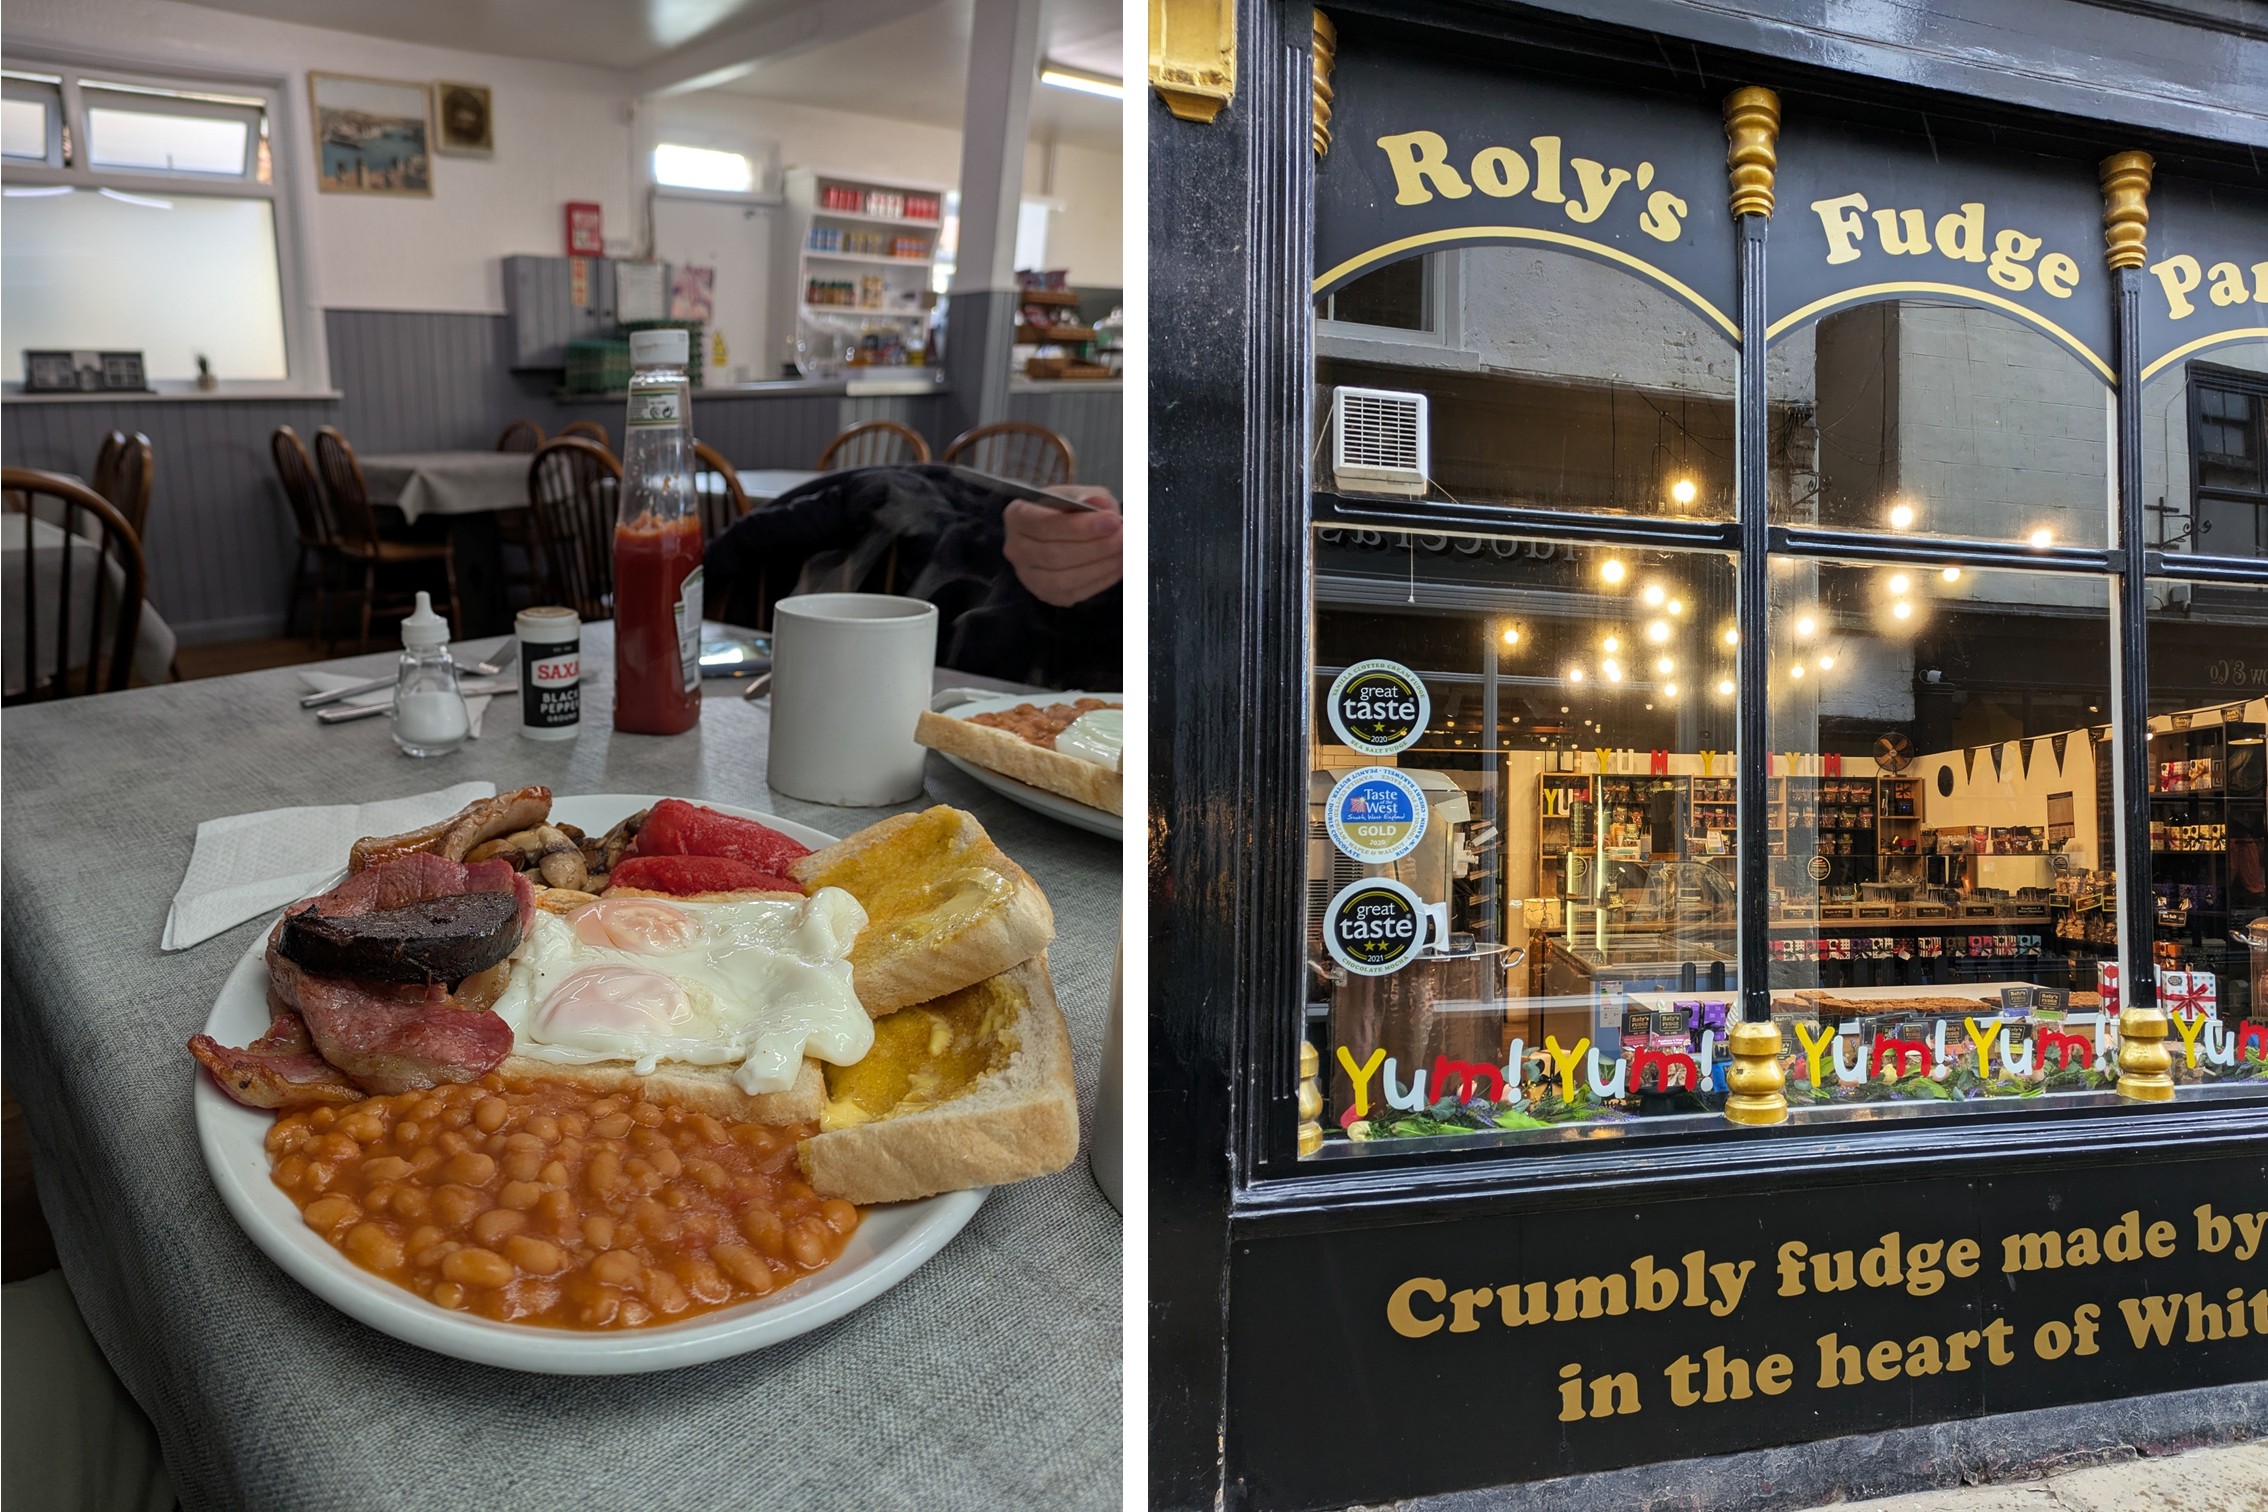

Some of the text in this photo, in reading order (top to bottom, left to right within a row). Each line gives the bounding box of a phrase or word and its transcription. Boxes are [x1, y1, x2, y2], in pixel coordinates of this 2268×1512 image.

[1377, 130, 1688, 242] Roly's
[1811, 192, 2080, 299] Fudge
[1332, 663, 1426, 699] VANILLA CLOTTED CREAM FUDGE
[1360, 685, 1399, 701] great
[1343, 698, 1416, 720] taste
[1350, 740, 1363, 750] SEA
[1385, 741, 1409, 753] FUDGE
[1370, 735, 1388, 743] 2020
[1350, 768, 1377, 779] PEANUT
[1382, 769, 1415, 789] BAKEWELL
[1331, 777, 1351, 798] BUTTER
[1364, 789, 1398, 800] Taste
[1365, 802, 1398, 814] West
[1412, 787, 1426, 812] CHERRY
[1383, 813, 1406, 821] England
[1358, 825, 1397, 837] GOLD
[1414, 817, 1426, 840] RAISIN
[1330, 829, 1360, 858] CHOCOLATE
[1395, 846, 1410, 858] RUM
[1356, 902, 1396, 920] great
[1339, 917, 1413, 940] taste
[1342, 956, 1409, 973] CHOCOLATE MOCHA
[1367, 954, 1384, 962] 2021
[1336, 1038, 1525, 1117] Yum!
[1545, 1030, 1715, 1104] Yum!
[1794, 1018, 1950, 1088] Yum!
[1964, 1014, 2107, 1080] Yum!
[1387, 1203, 2268, 1338] Crumbly fudge made by
[1558, 1287, 2268, 1422] in the heart of Whit
